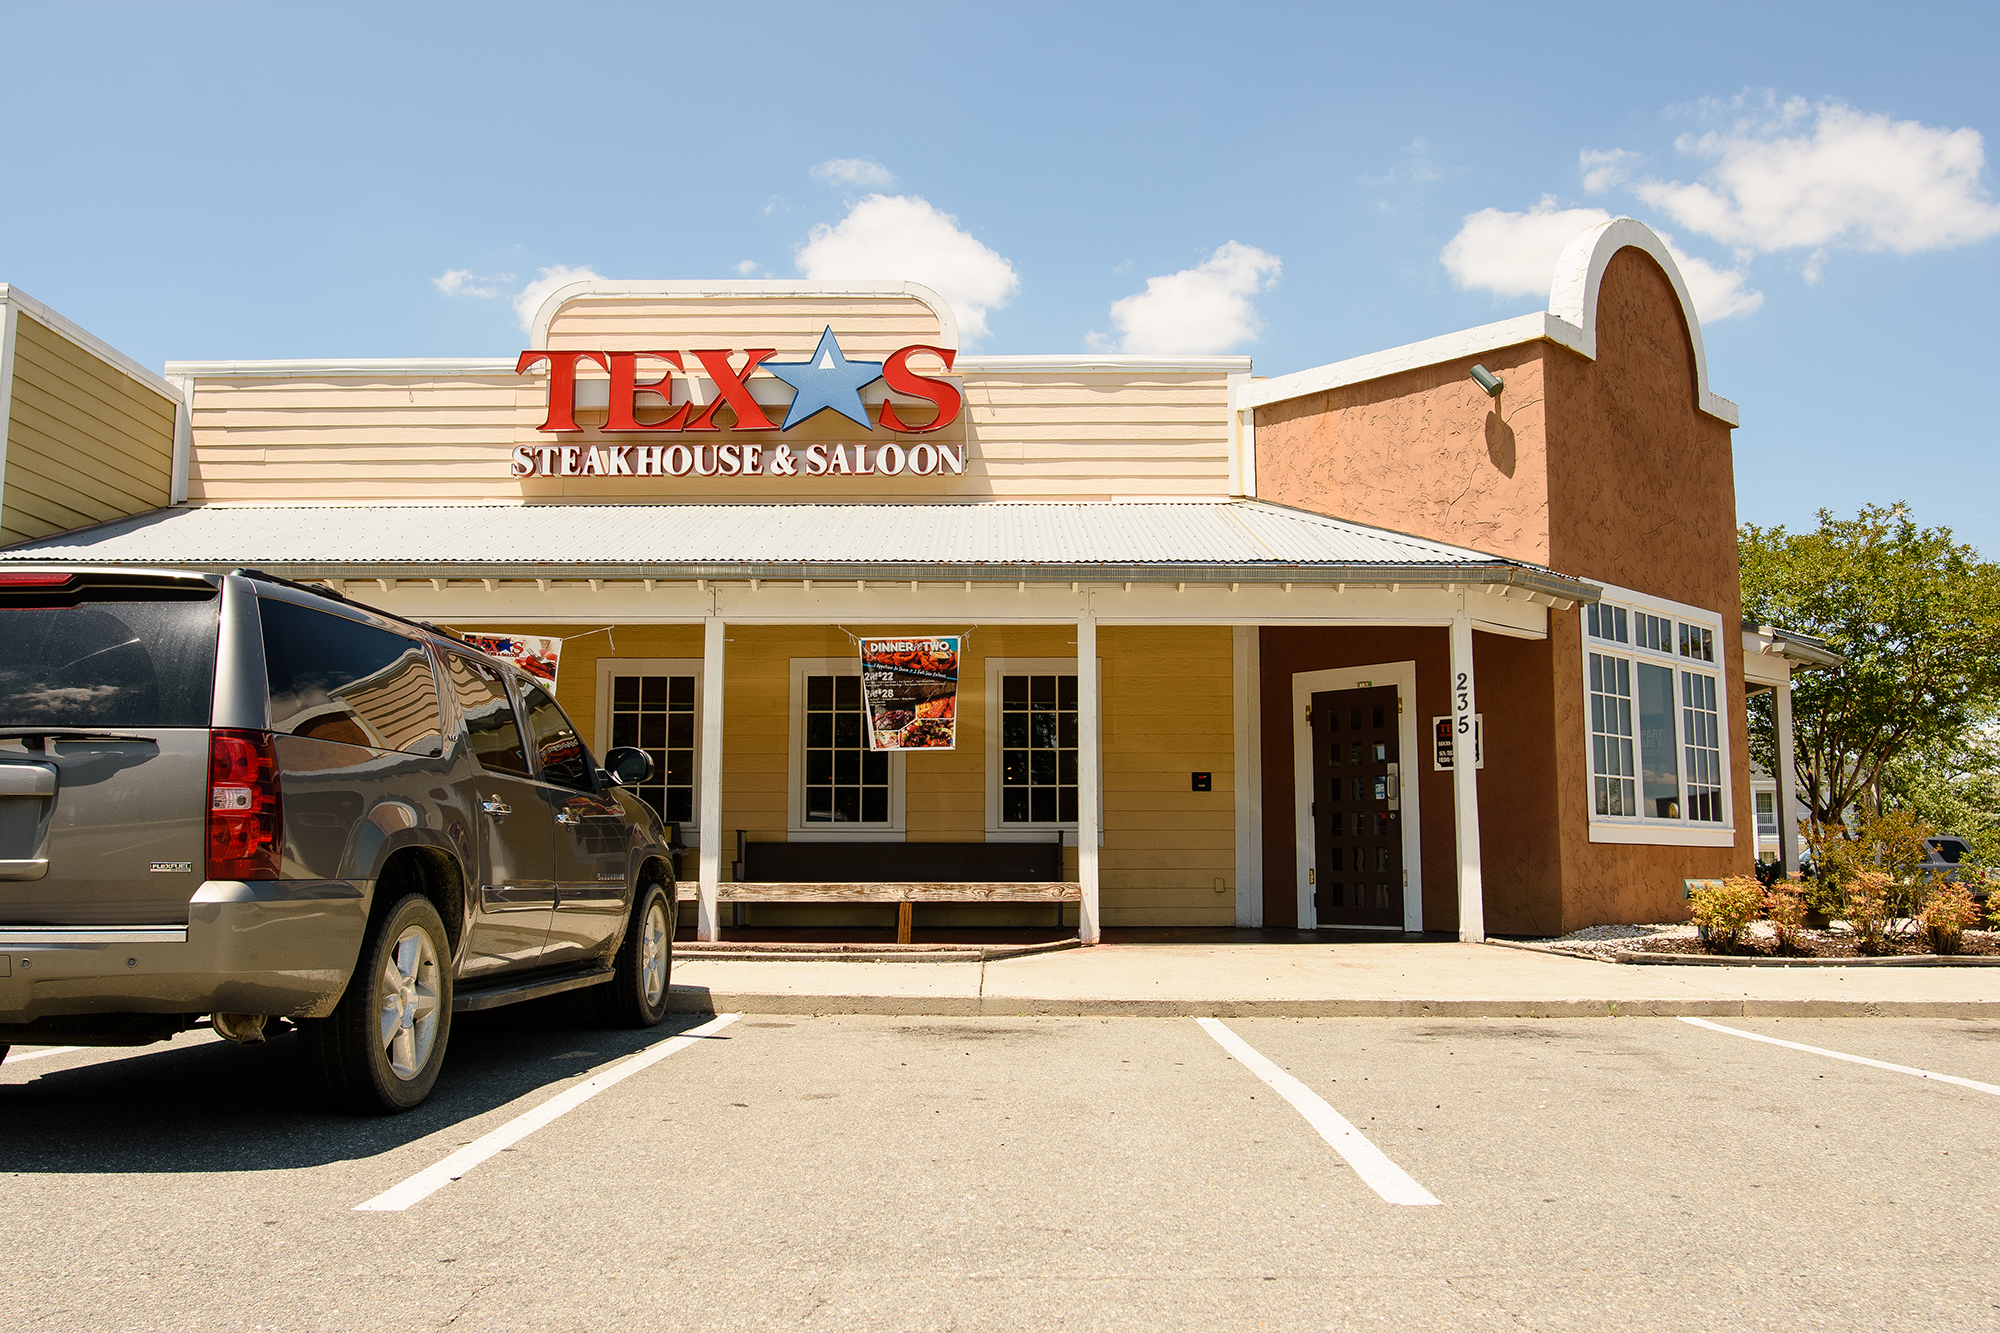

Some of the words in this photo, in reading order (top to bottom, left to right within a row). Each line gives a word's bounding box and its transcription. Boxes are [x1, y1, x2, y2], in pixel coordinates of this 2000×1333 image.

[511, 443, 764, 477] STEAKHOUSE
[769, 444, 798, 477] &
[804, 443, 965, 477] SALOON
[870, 641, 913, 653] DINNER
[922, 641, 950, 652] TWO
[1456, 672, 1469, 734] 235
